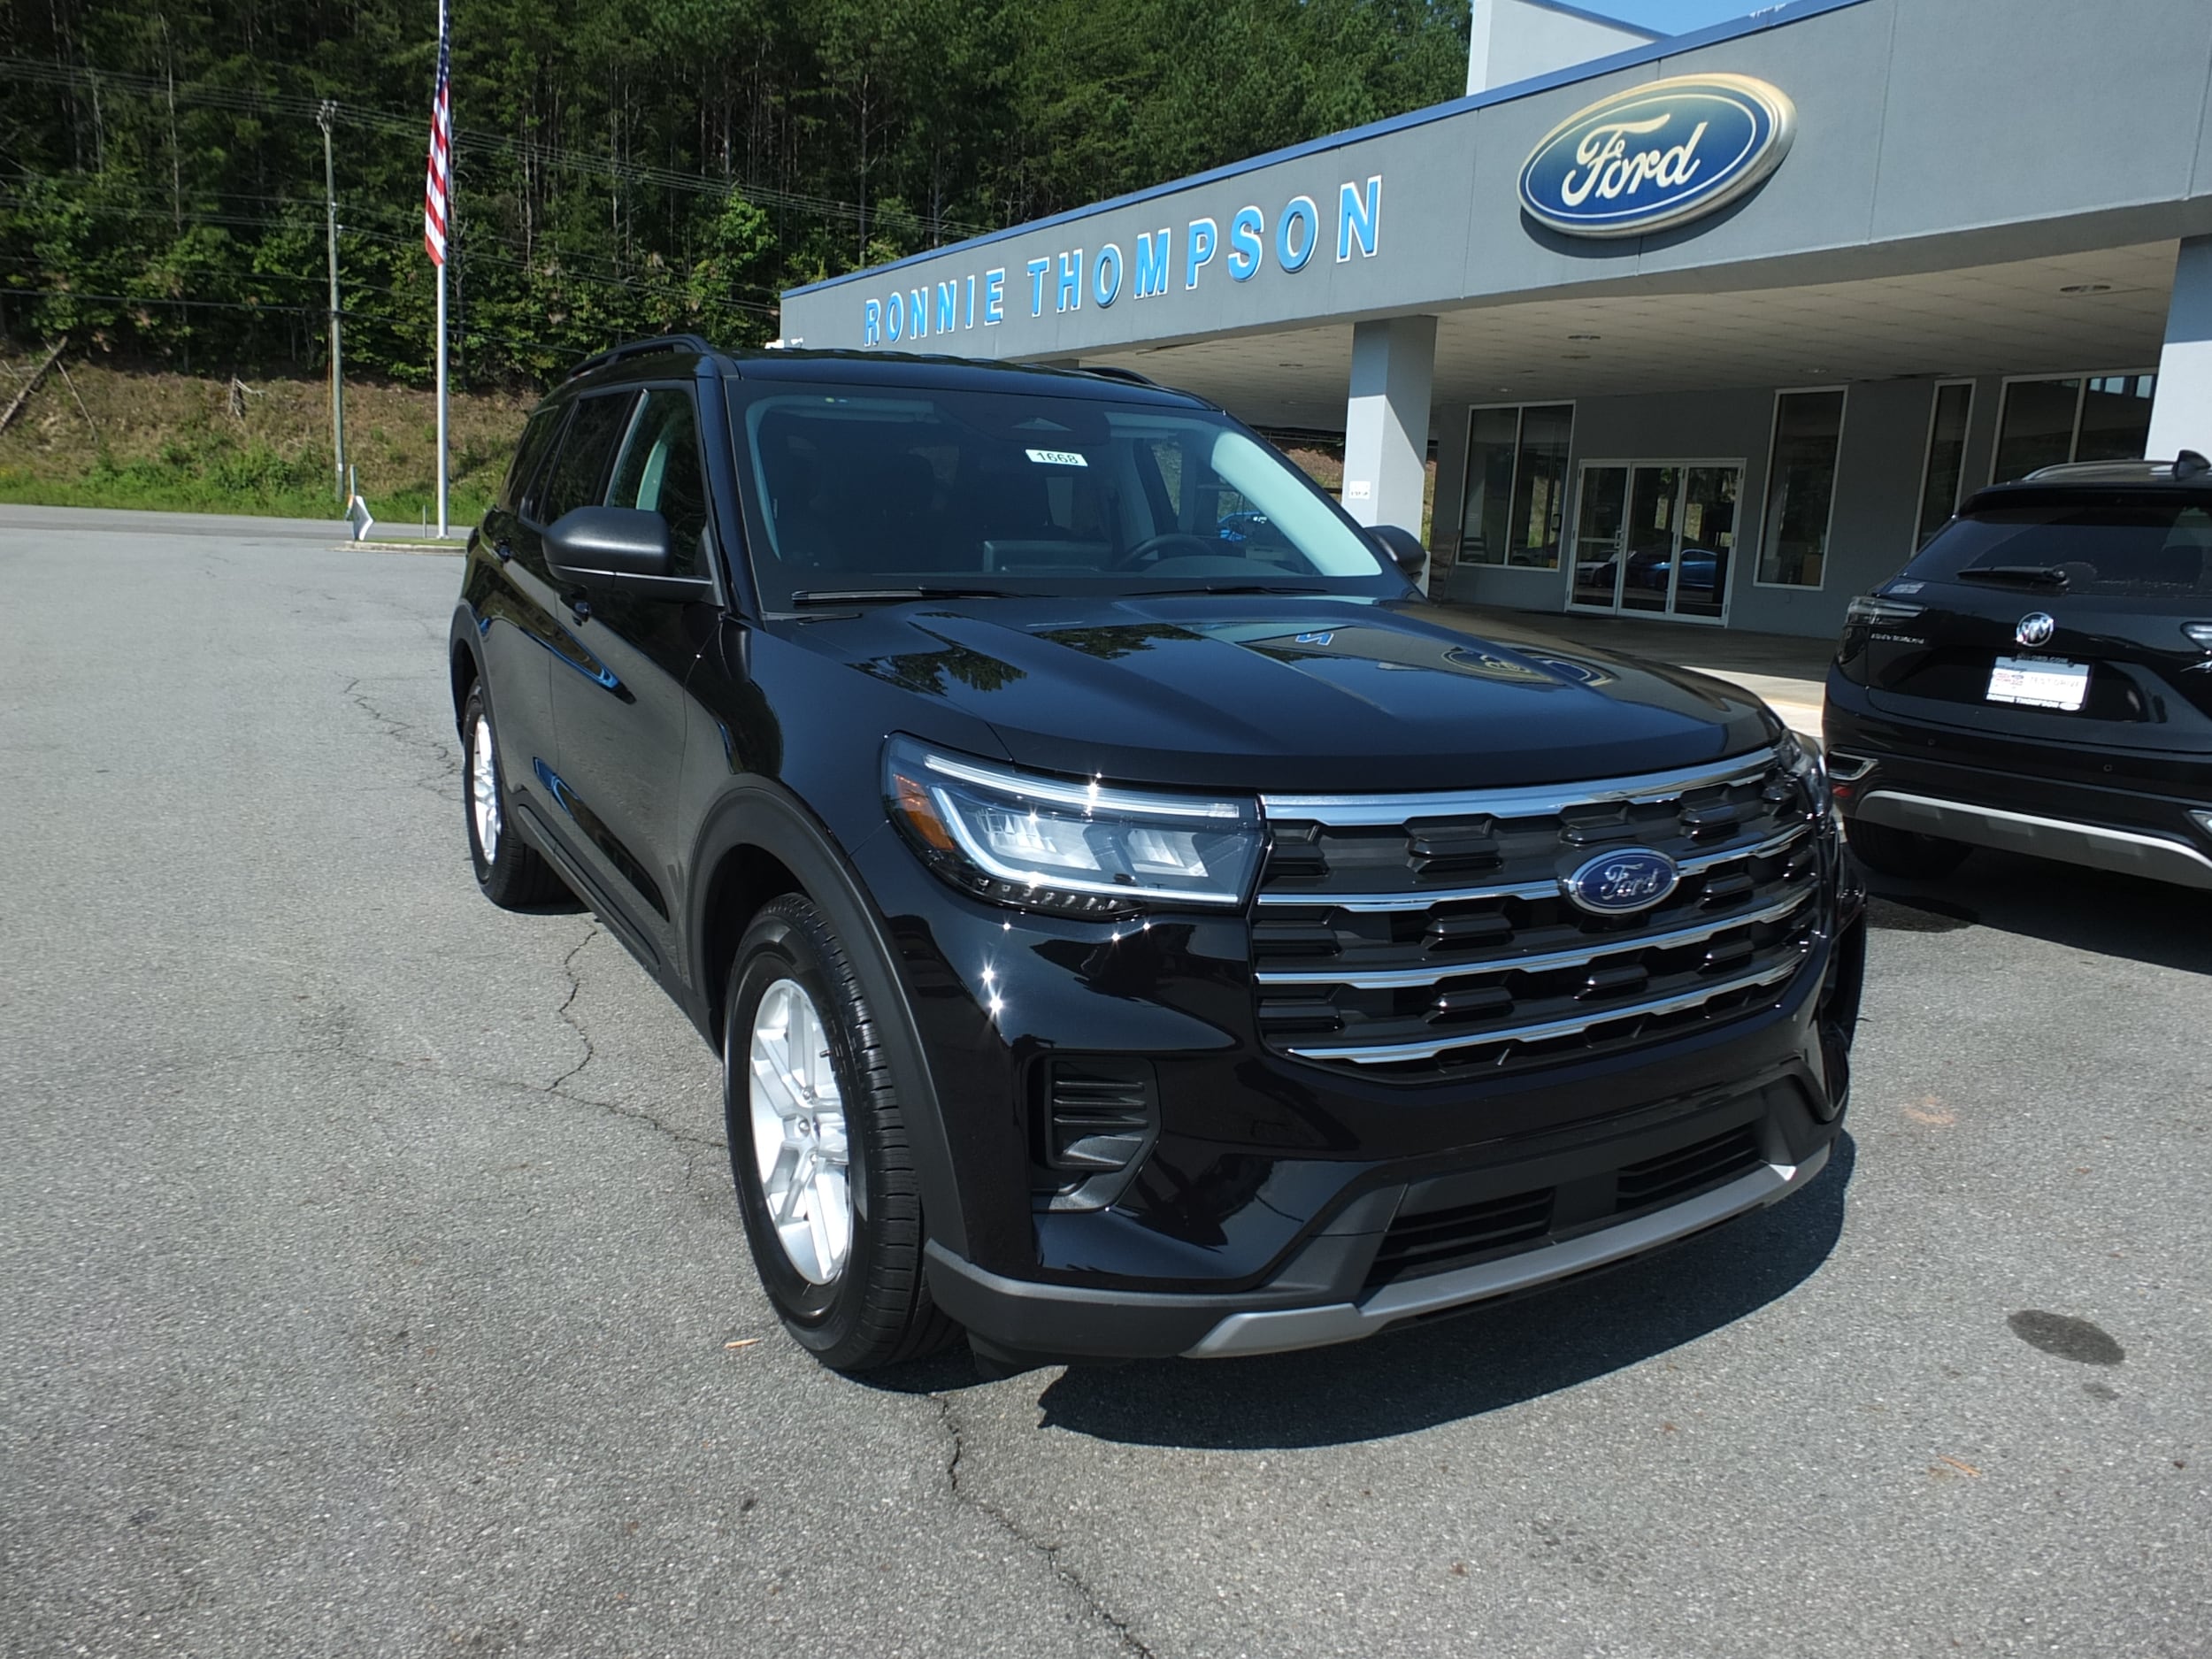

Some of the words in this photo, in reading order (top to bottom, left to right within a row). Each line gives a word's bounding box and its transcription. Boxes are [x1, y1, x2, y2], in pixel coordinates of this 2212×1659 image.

[1561, 112, 1709, 207] Ford
[864, 266, 1005, 348] RONNIE
[1026, 173, 1382, 319] THOMPSON
[1038, 452, 1078, 464] 1668
[1601, 863, 1658, 900] Ford
